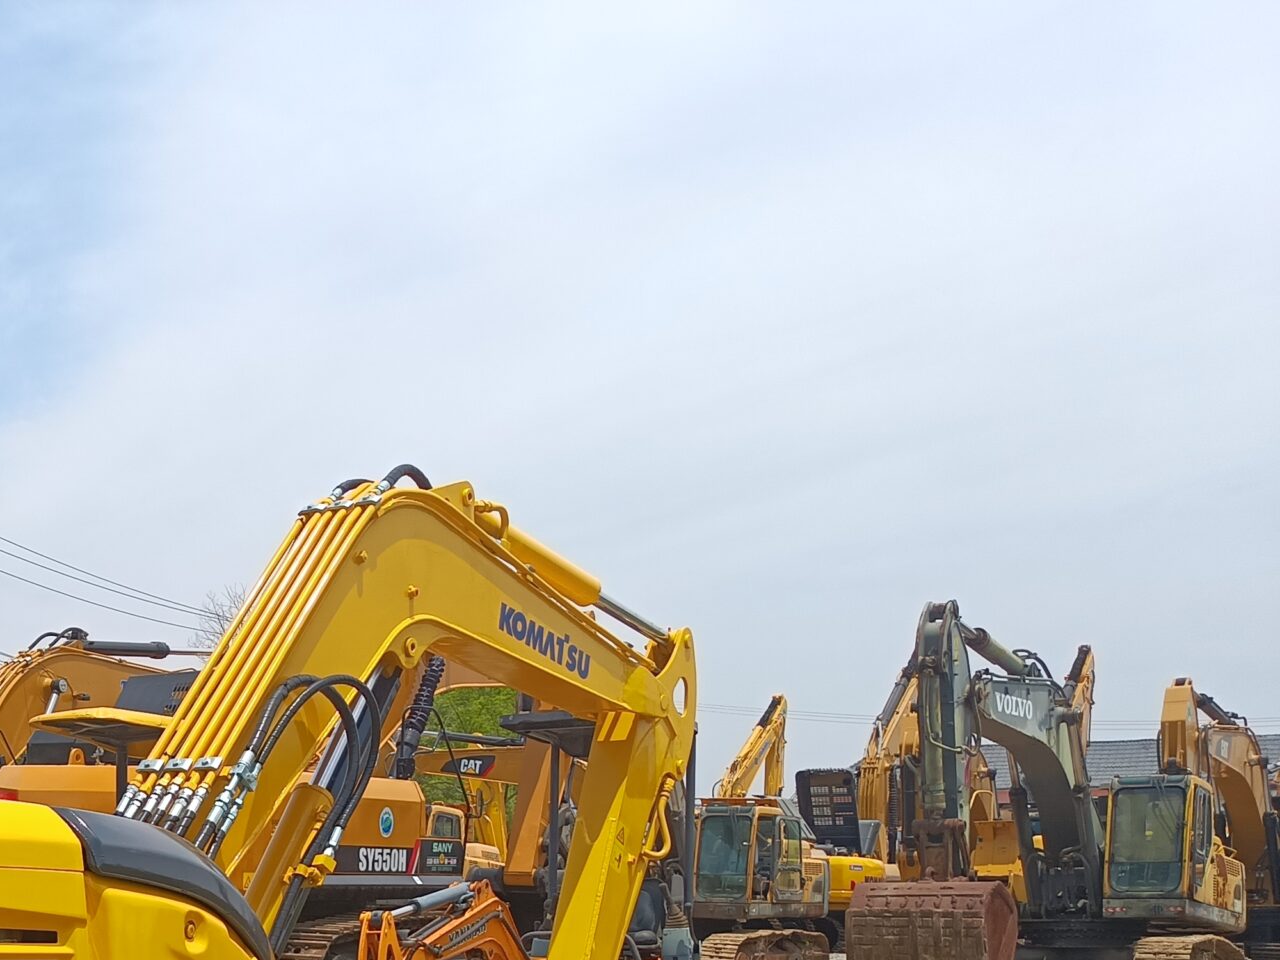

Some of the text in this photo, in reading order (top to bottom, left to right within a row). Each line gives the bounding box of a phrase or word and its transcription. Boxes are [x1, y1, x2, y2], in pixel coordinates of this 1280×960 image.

[498, 602, 591, 679] KOMATSU
[995, 691, 1033, 720] VOLVO
[460, 759, 483, 775] CAT
[358, 847, 407, 872] SY550H
[432, 842, 453, 853] SANY
